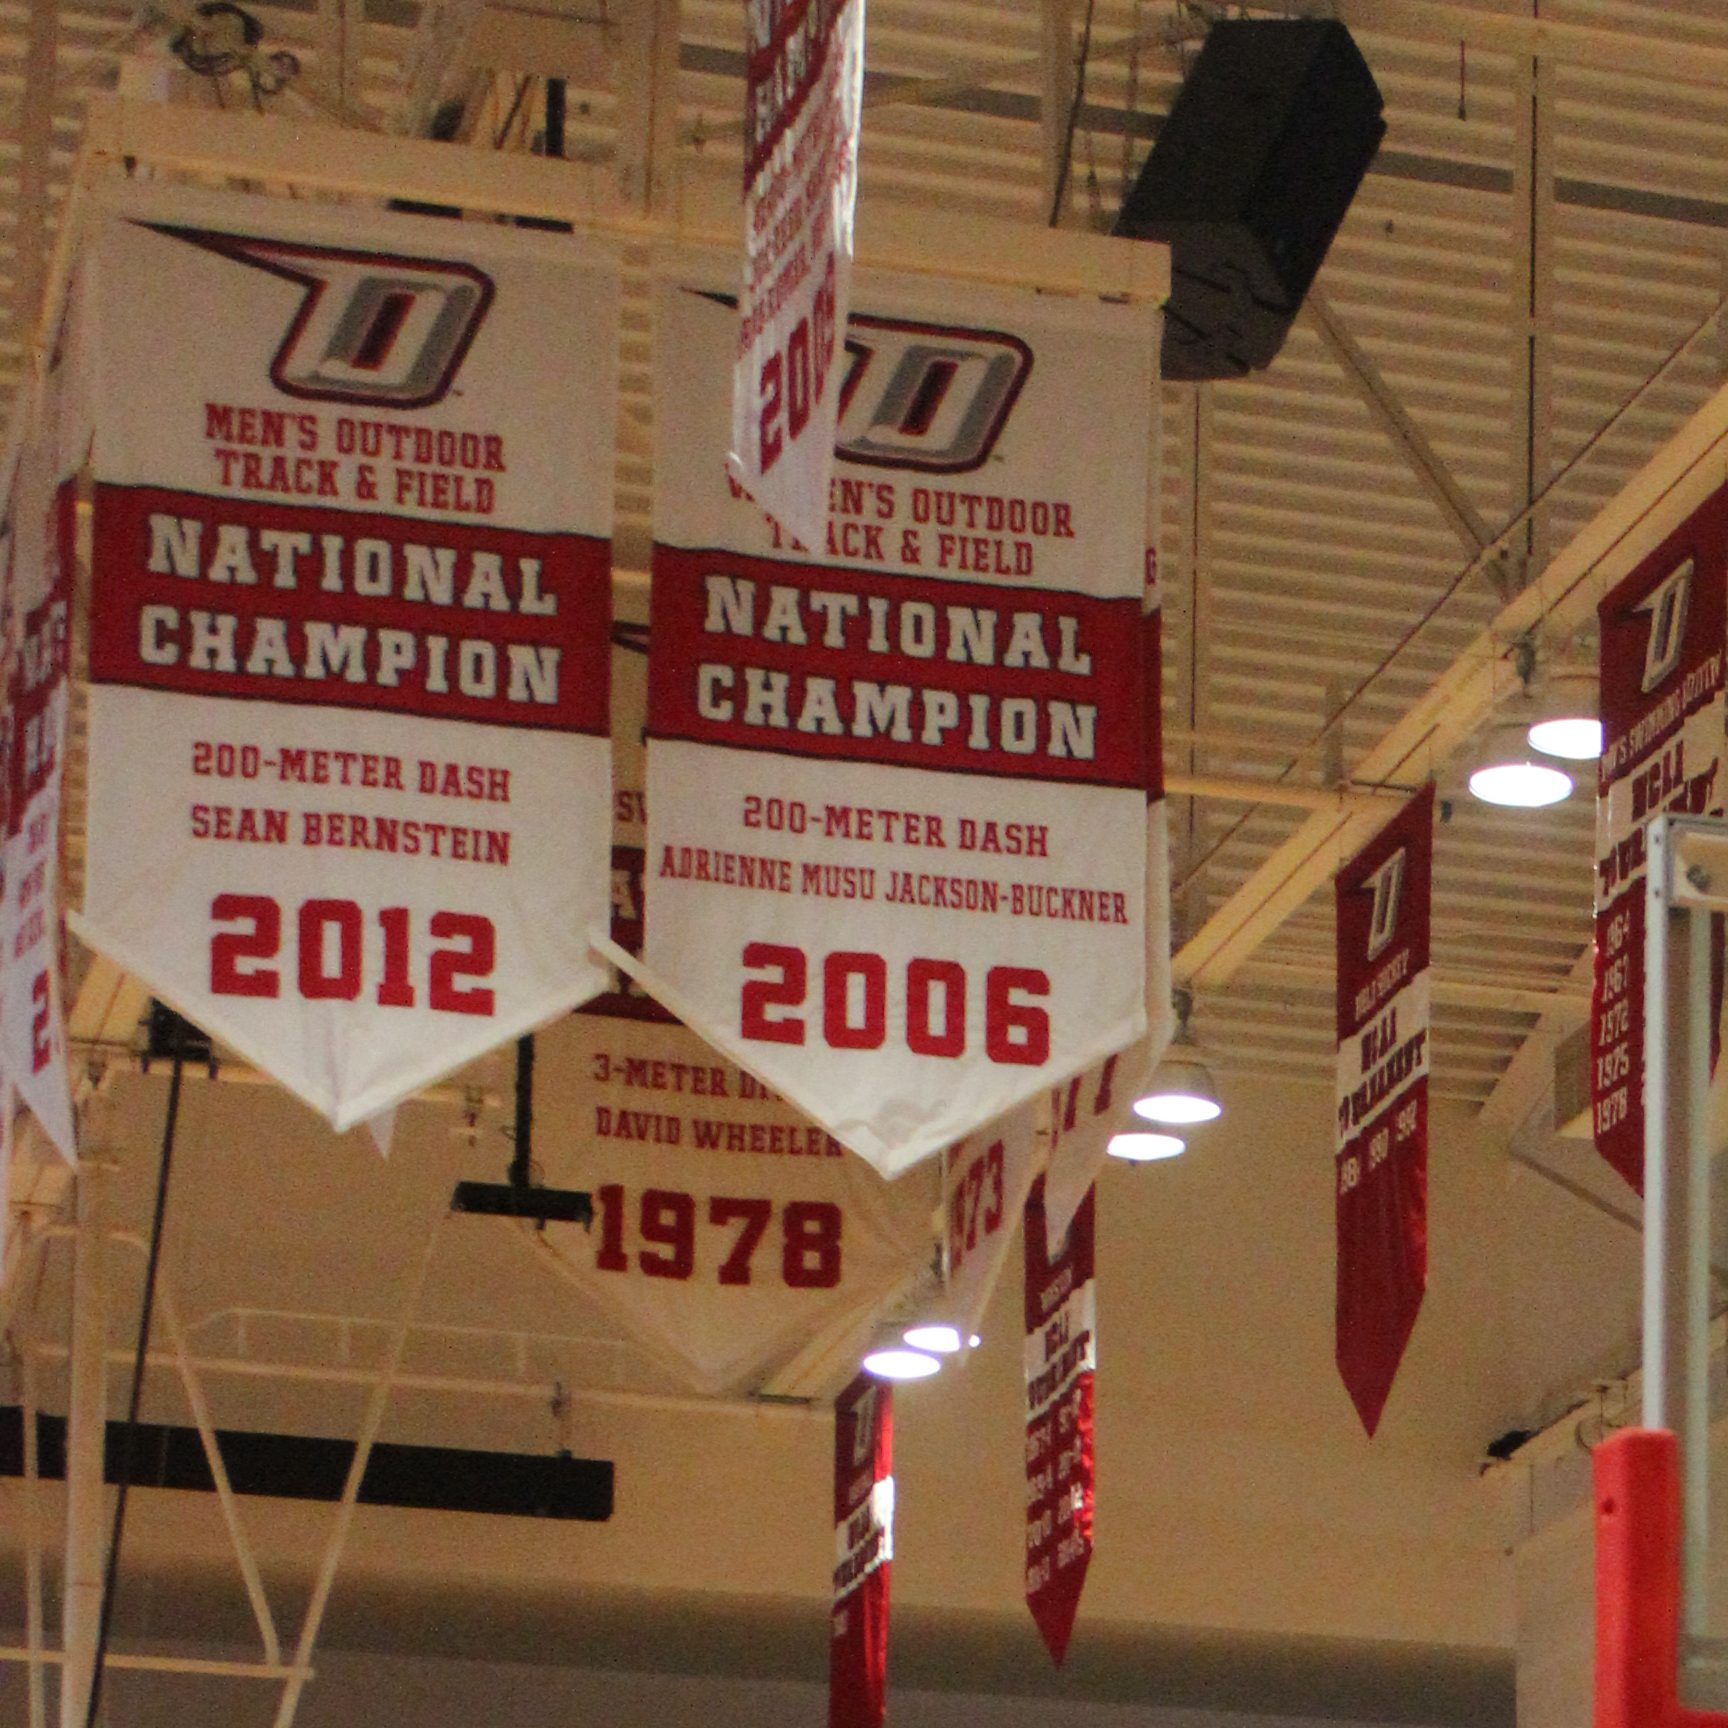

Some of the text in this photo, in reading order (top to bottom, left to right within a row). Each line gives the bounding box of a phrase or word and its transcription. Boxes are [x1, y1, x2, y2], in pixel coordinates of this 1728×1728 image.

[205, 403, 505, 472] MEN'S OUTDOOR
[215, 450, 496, 514] TRACK & FIELD
[913, 487, 1075, 538] OUTDOOR
[148, 513, 557, 615] NATIONAL
[902, 530, 922, 565] &
[938, 535, 1034, 576] FIELD
[139, 604, 561, 704] CHAMPION
[703, 575, 1092, 676] NATIONAL
[698, 664, 1097, 760] CHAMPION
[191, 741, 511, 802] 200-METER DASH
[191, 804, 511, 865] SEAN BERNSTEIN
[743, 795, 1049, 857] 200-METER DASH
[660, 844, 791, 895] ADRIENNE
[802, 863, 875, 901] MUSU
[885, 871, 1129, 924] JACKSON-BUCKNER
[210, 894, 495, 1017] 2012
[741, 942, 1050, 1067] 2006
[594, 1053, 729, 1098] 3-METER
[596, 1106, 681, 1145] DAVID
[596, 1183, 842, 1288] 1978
